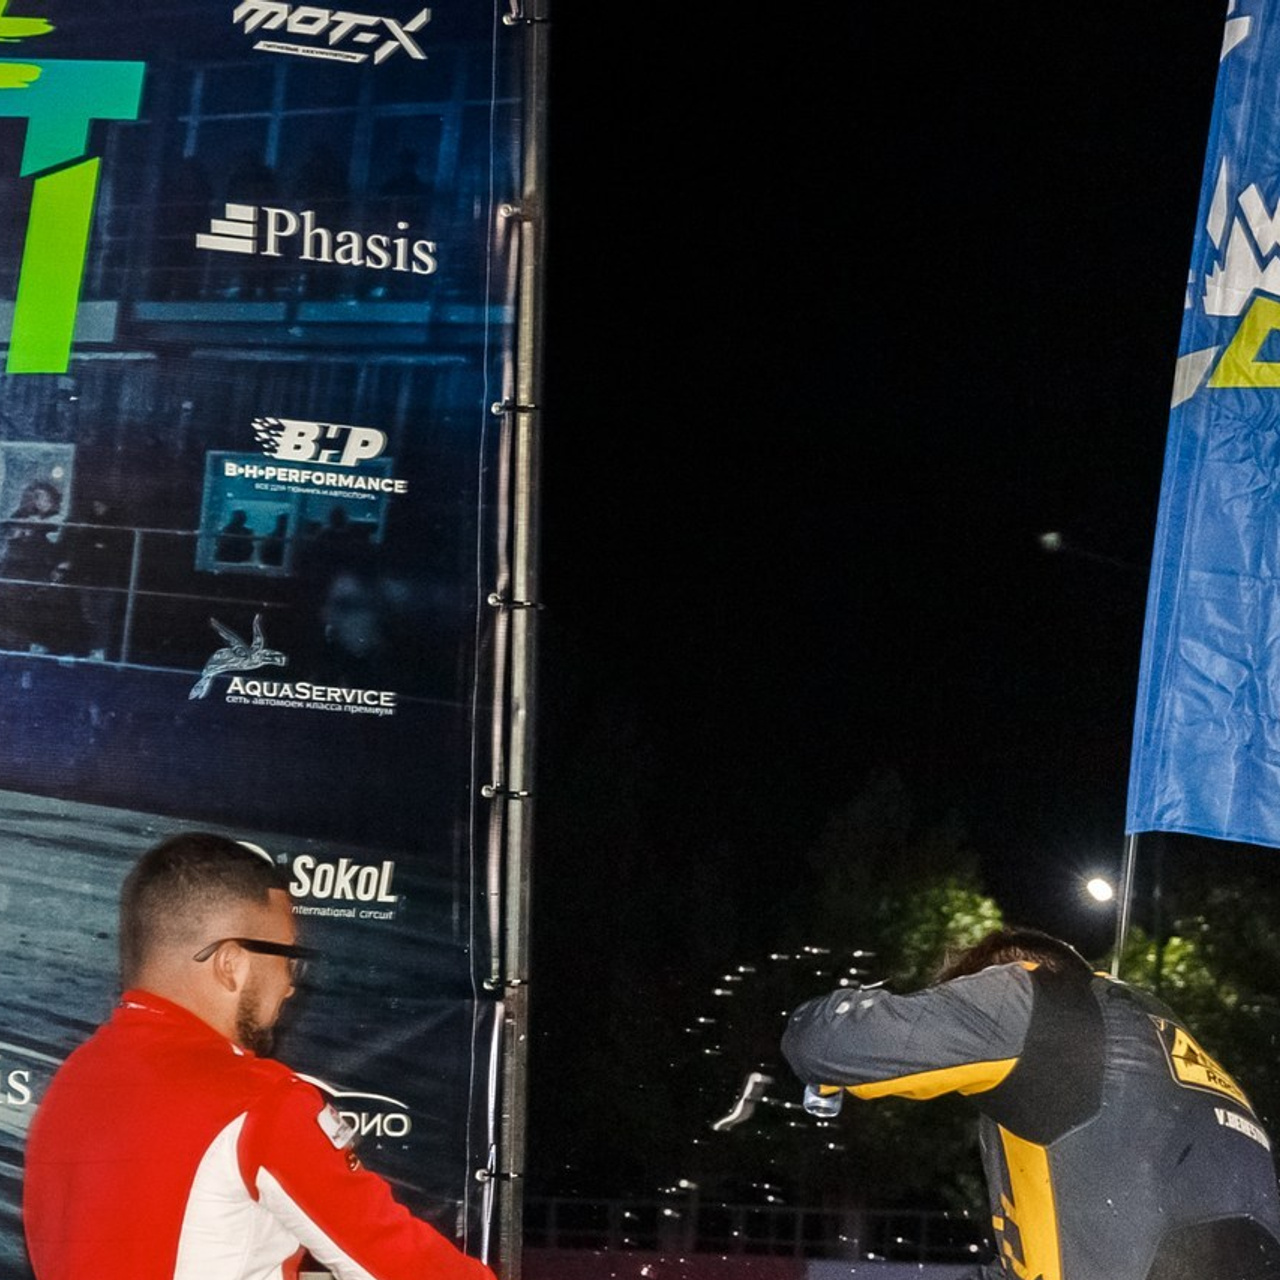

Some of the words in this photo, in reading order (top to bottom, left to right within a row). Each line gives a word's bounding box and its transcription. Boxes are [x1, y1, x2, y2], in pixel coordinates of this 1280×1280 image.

[259, 206, 438, 275] Phasis
[306, 703, 342, 712] класса
[344, 704, 393, 716] премиум
[291, 905, 356, 918] nternational
[359, 909, 394, 920] circuit
